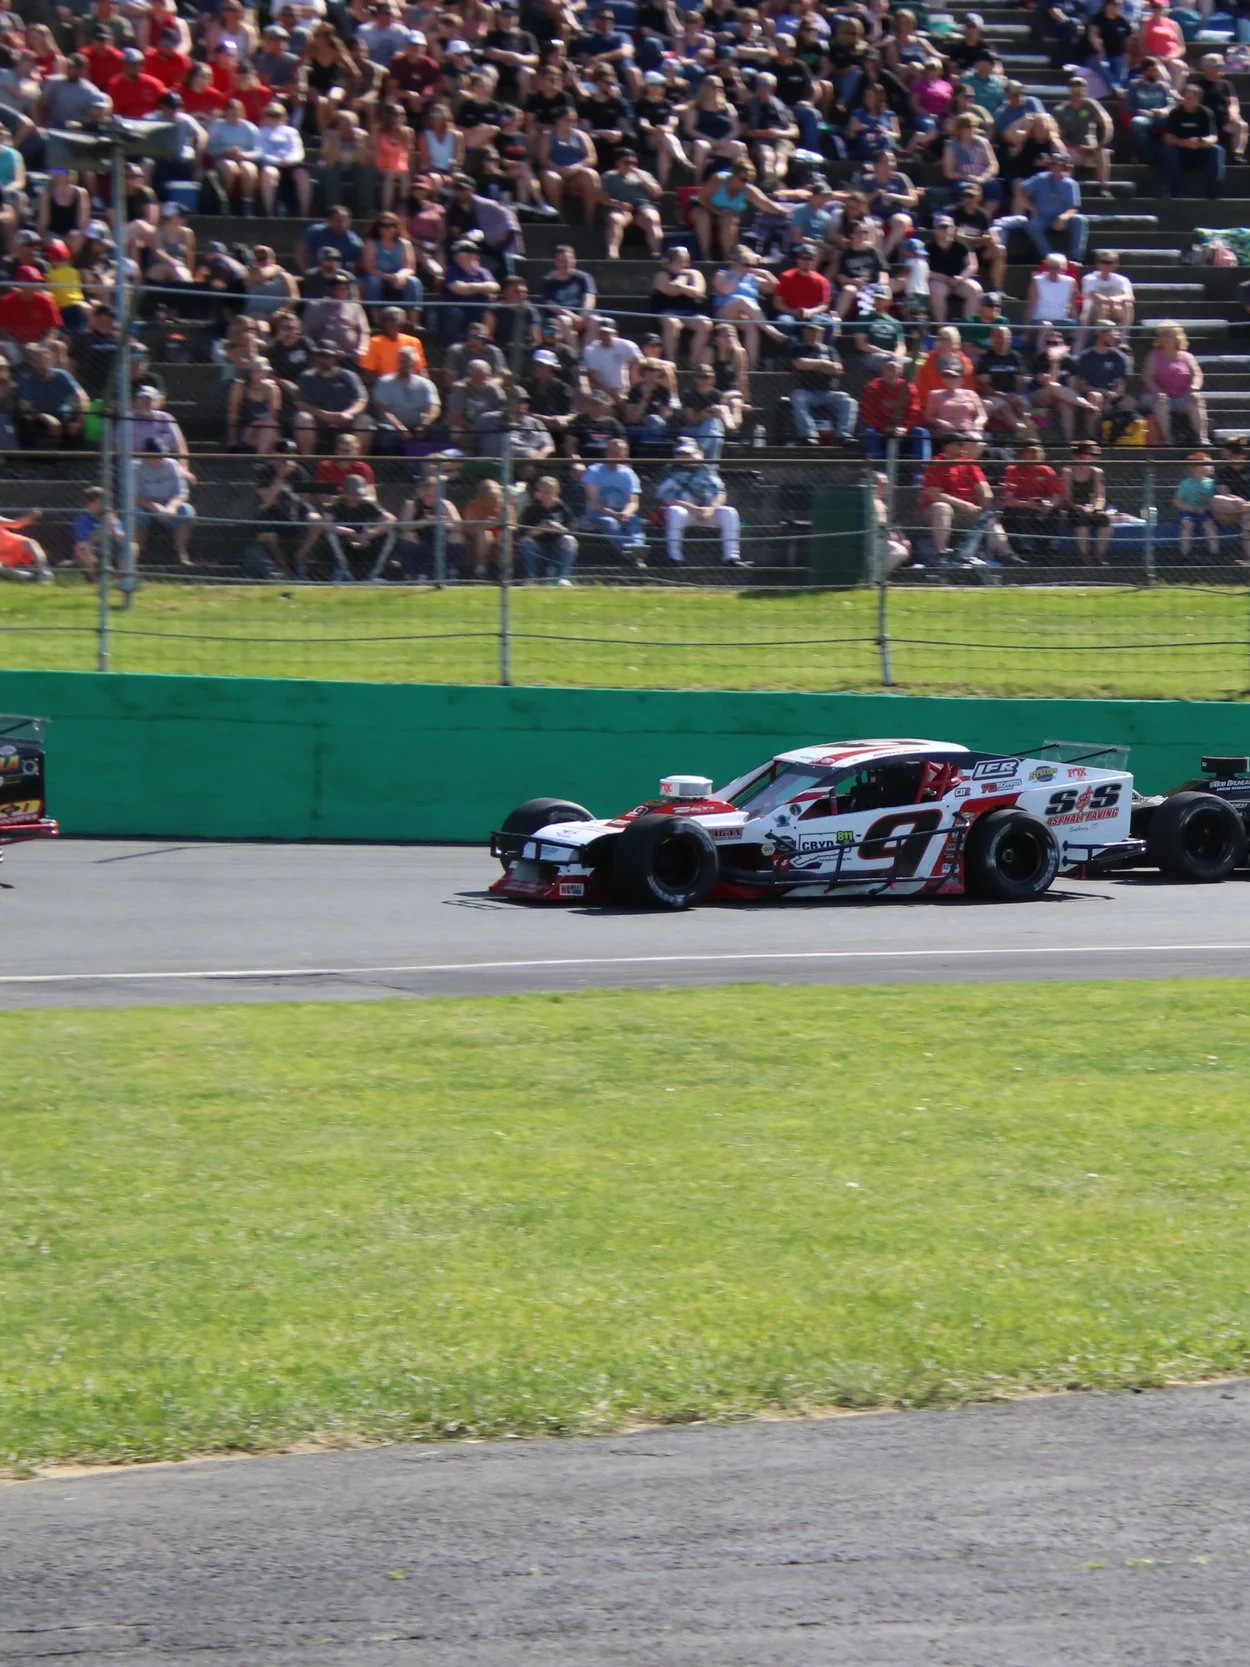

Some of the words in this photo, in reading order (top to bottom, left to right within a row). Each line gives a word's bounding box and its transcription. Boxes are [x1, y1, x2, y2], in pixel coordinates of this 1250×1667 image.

[975, 760, 1018, 778] LFR
[1044, 782, 1122, 816] S&S
[1047, 811, 1086, 826] ASPHALT
[1086, 807, 1120, 822] PAVING
[836, 830, 854, 842] 811
[857, 807, 943, 880] 9
